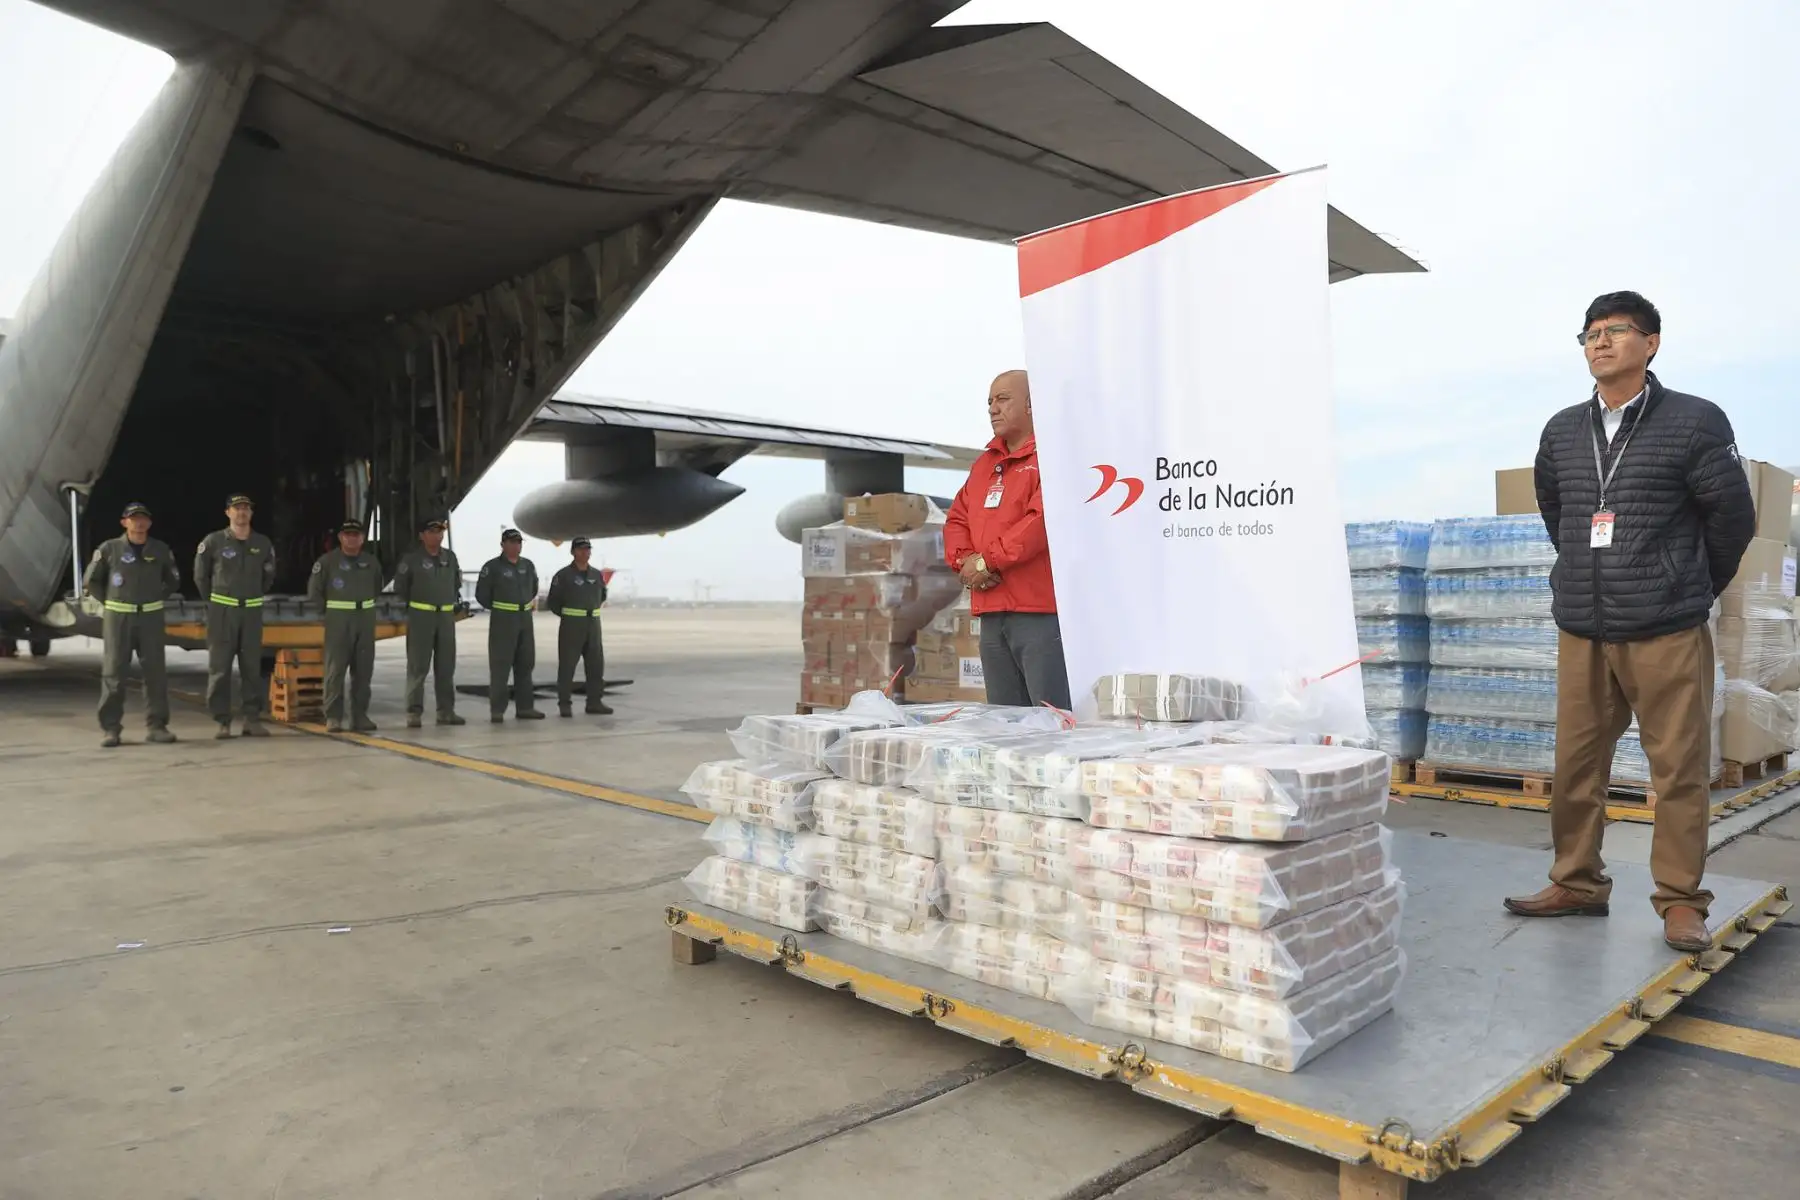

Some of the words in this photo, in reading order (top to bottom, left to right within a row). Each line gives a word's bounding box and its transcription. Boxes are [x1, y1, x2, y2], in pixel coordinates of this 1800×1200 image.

[1156, 457, 1217, 481] Banco
[1158, 488, 1182, 512] de
[1188, 487, 1206, 511] la
[1216, 480, 1294, 508] Nación
[1163, 523, 1174, 538] el
[1177, 524, 1214, 538] banco
[1218, 521, 1233, 536] de
[1237, 520, 1274, 536] todos
